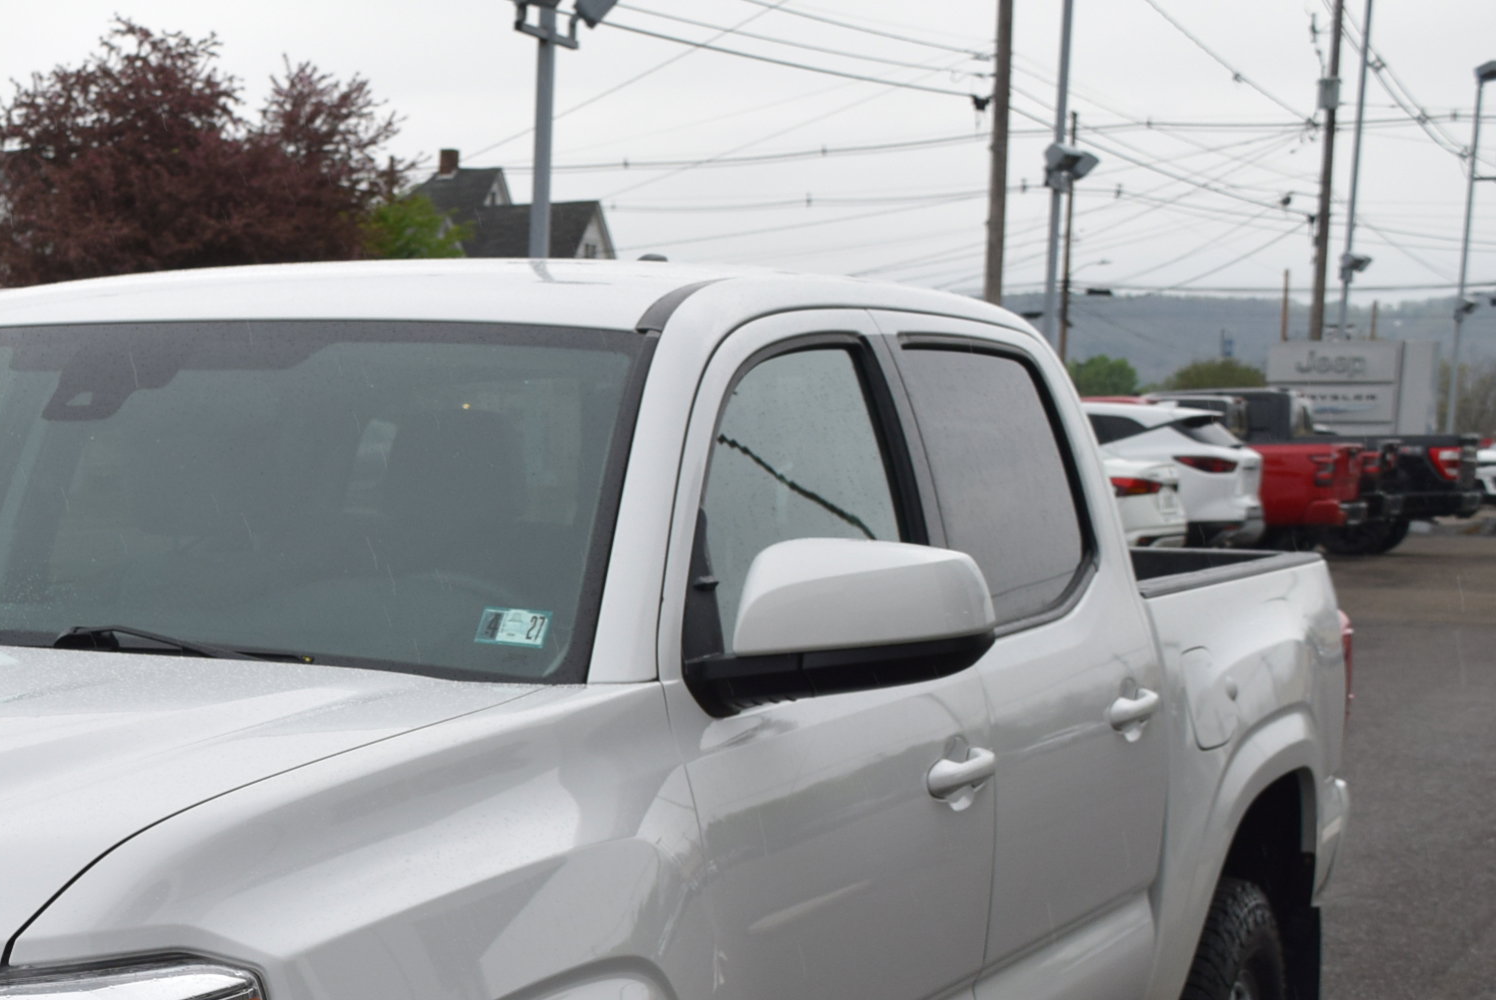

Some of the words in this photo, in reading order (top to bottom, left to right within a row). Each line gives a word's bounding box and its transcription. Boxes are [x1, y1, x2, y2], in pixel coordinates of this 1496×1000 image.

[1295, 349, 1367, 378] Jeep
[1298, 393, 1377, 401] RYSLER
[525, 615, 546, 641] 27
